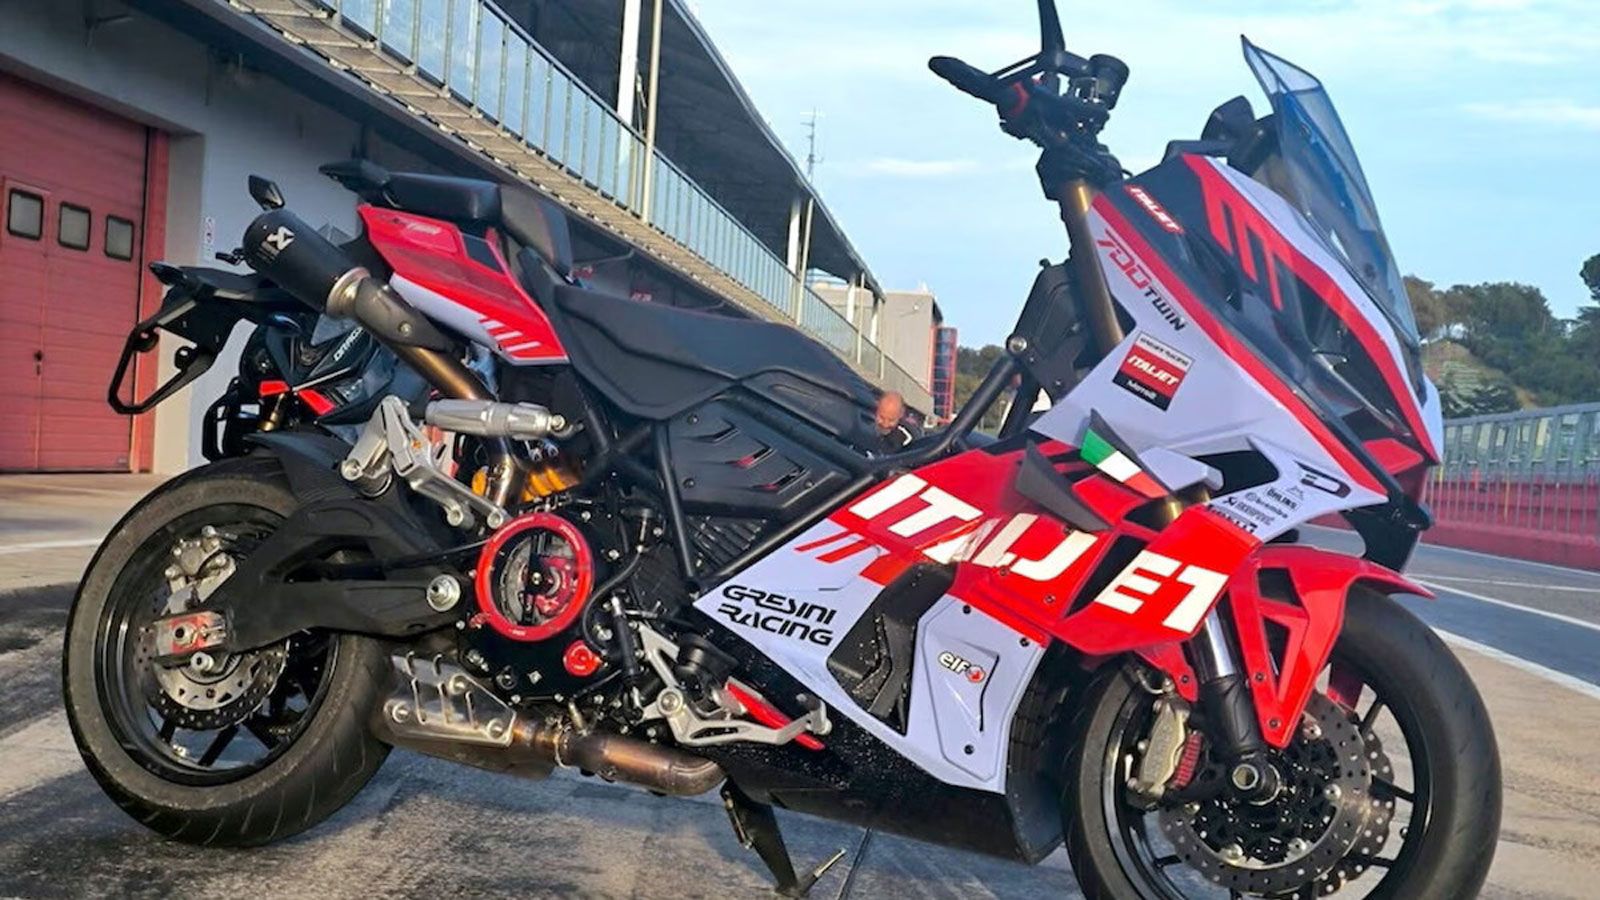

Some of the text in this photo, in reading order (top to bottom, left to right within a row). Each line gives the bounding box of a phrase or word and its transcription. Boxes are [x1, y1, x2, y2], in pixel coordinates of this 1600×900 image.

[1130, 187, 1183, 232] ITALJET
[1127, 355, 1180, 385] ITALJET
[848, 473, 1229, 633] ITALJET
[717, 602, 833, 646] RACING
[722, 584, 838, 625] GRESINI
[939, 651, 971, 674] elf
